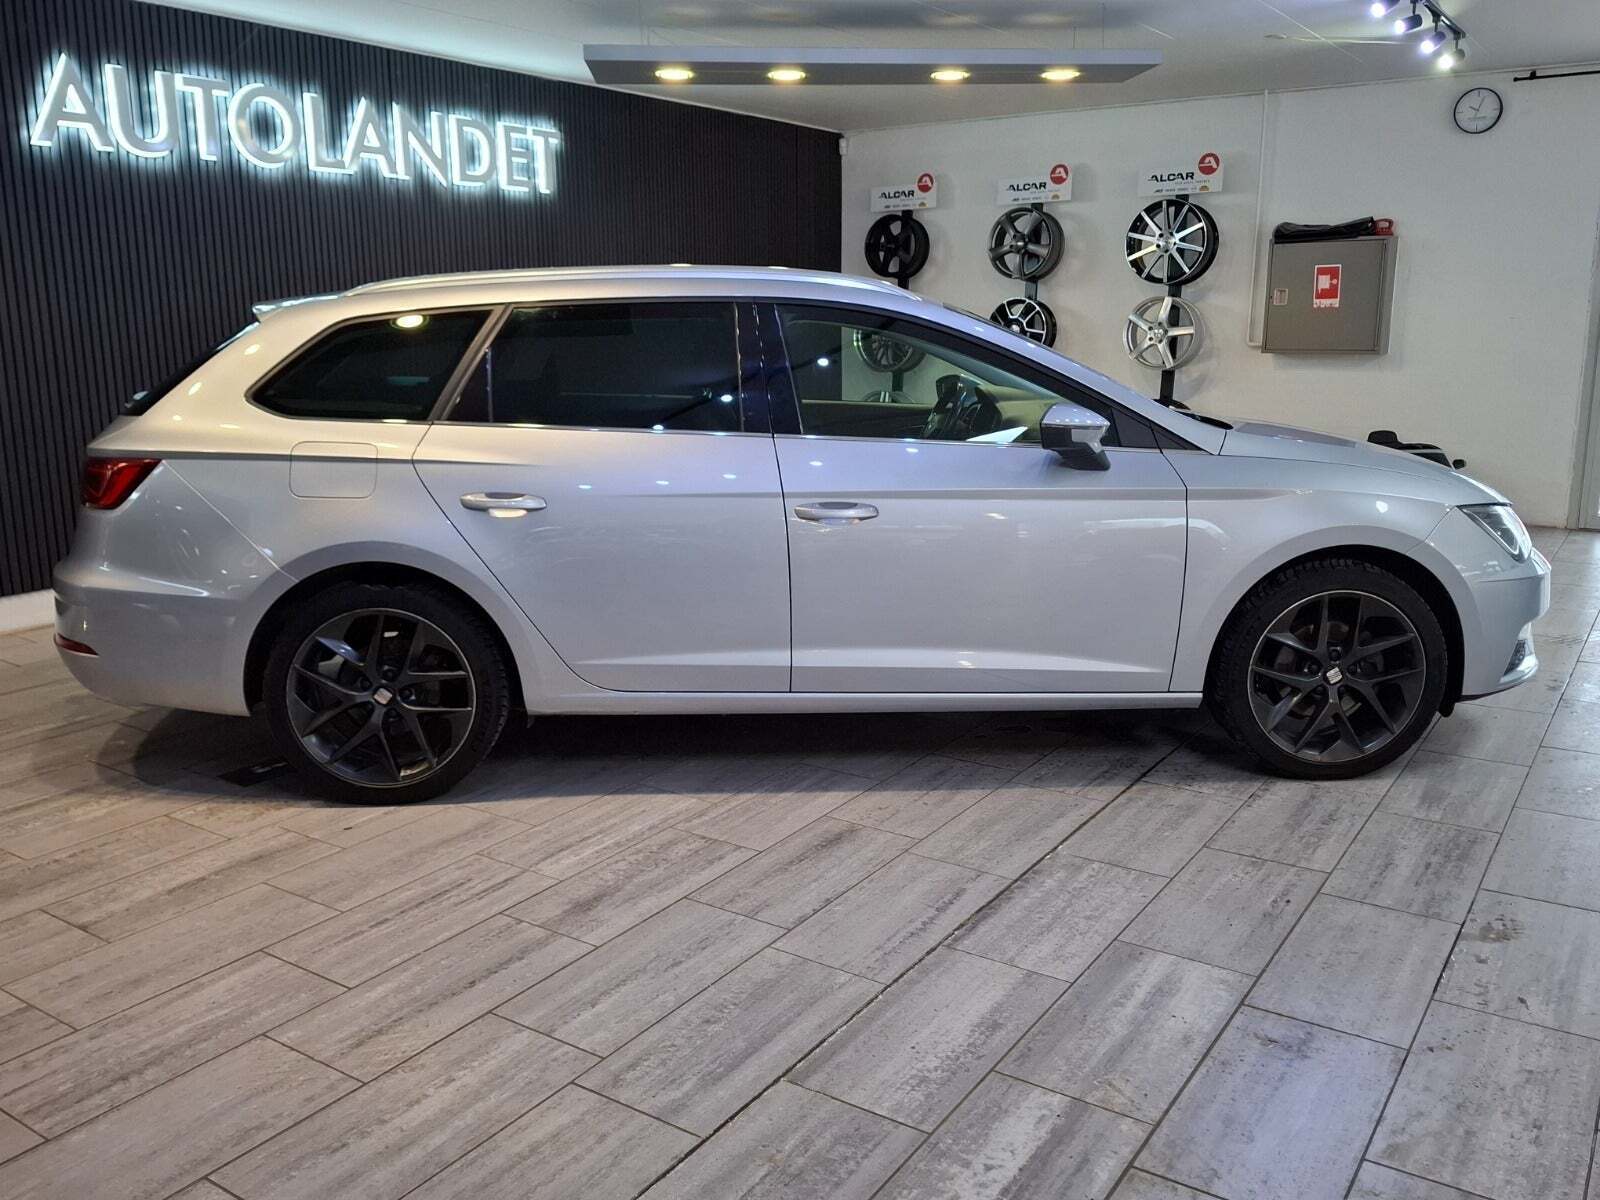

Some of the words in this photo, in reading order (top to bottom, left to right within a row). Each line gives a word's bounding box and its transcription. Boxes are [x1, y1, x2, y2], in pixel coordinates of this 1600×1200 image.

[30, 53, 561, 194] AUTOLANDET
[1148, 171, 1195, 183] ALCAR
[1006, 181, 1047, 192] ALCAR
[879, 190, 915, 200] ALCAR
